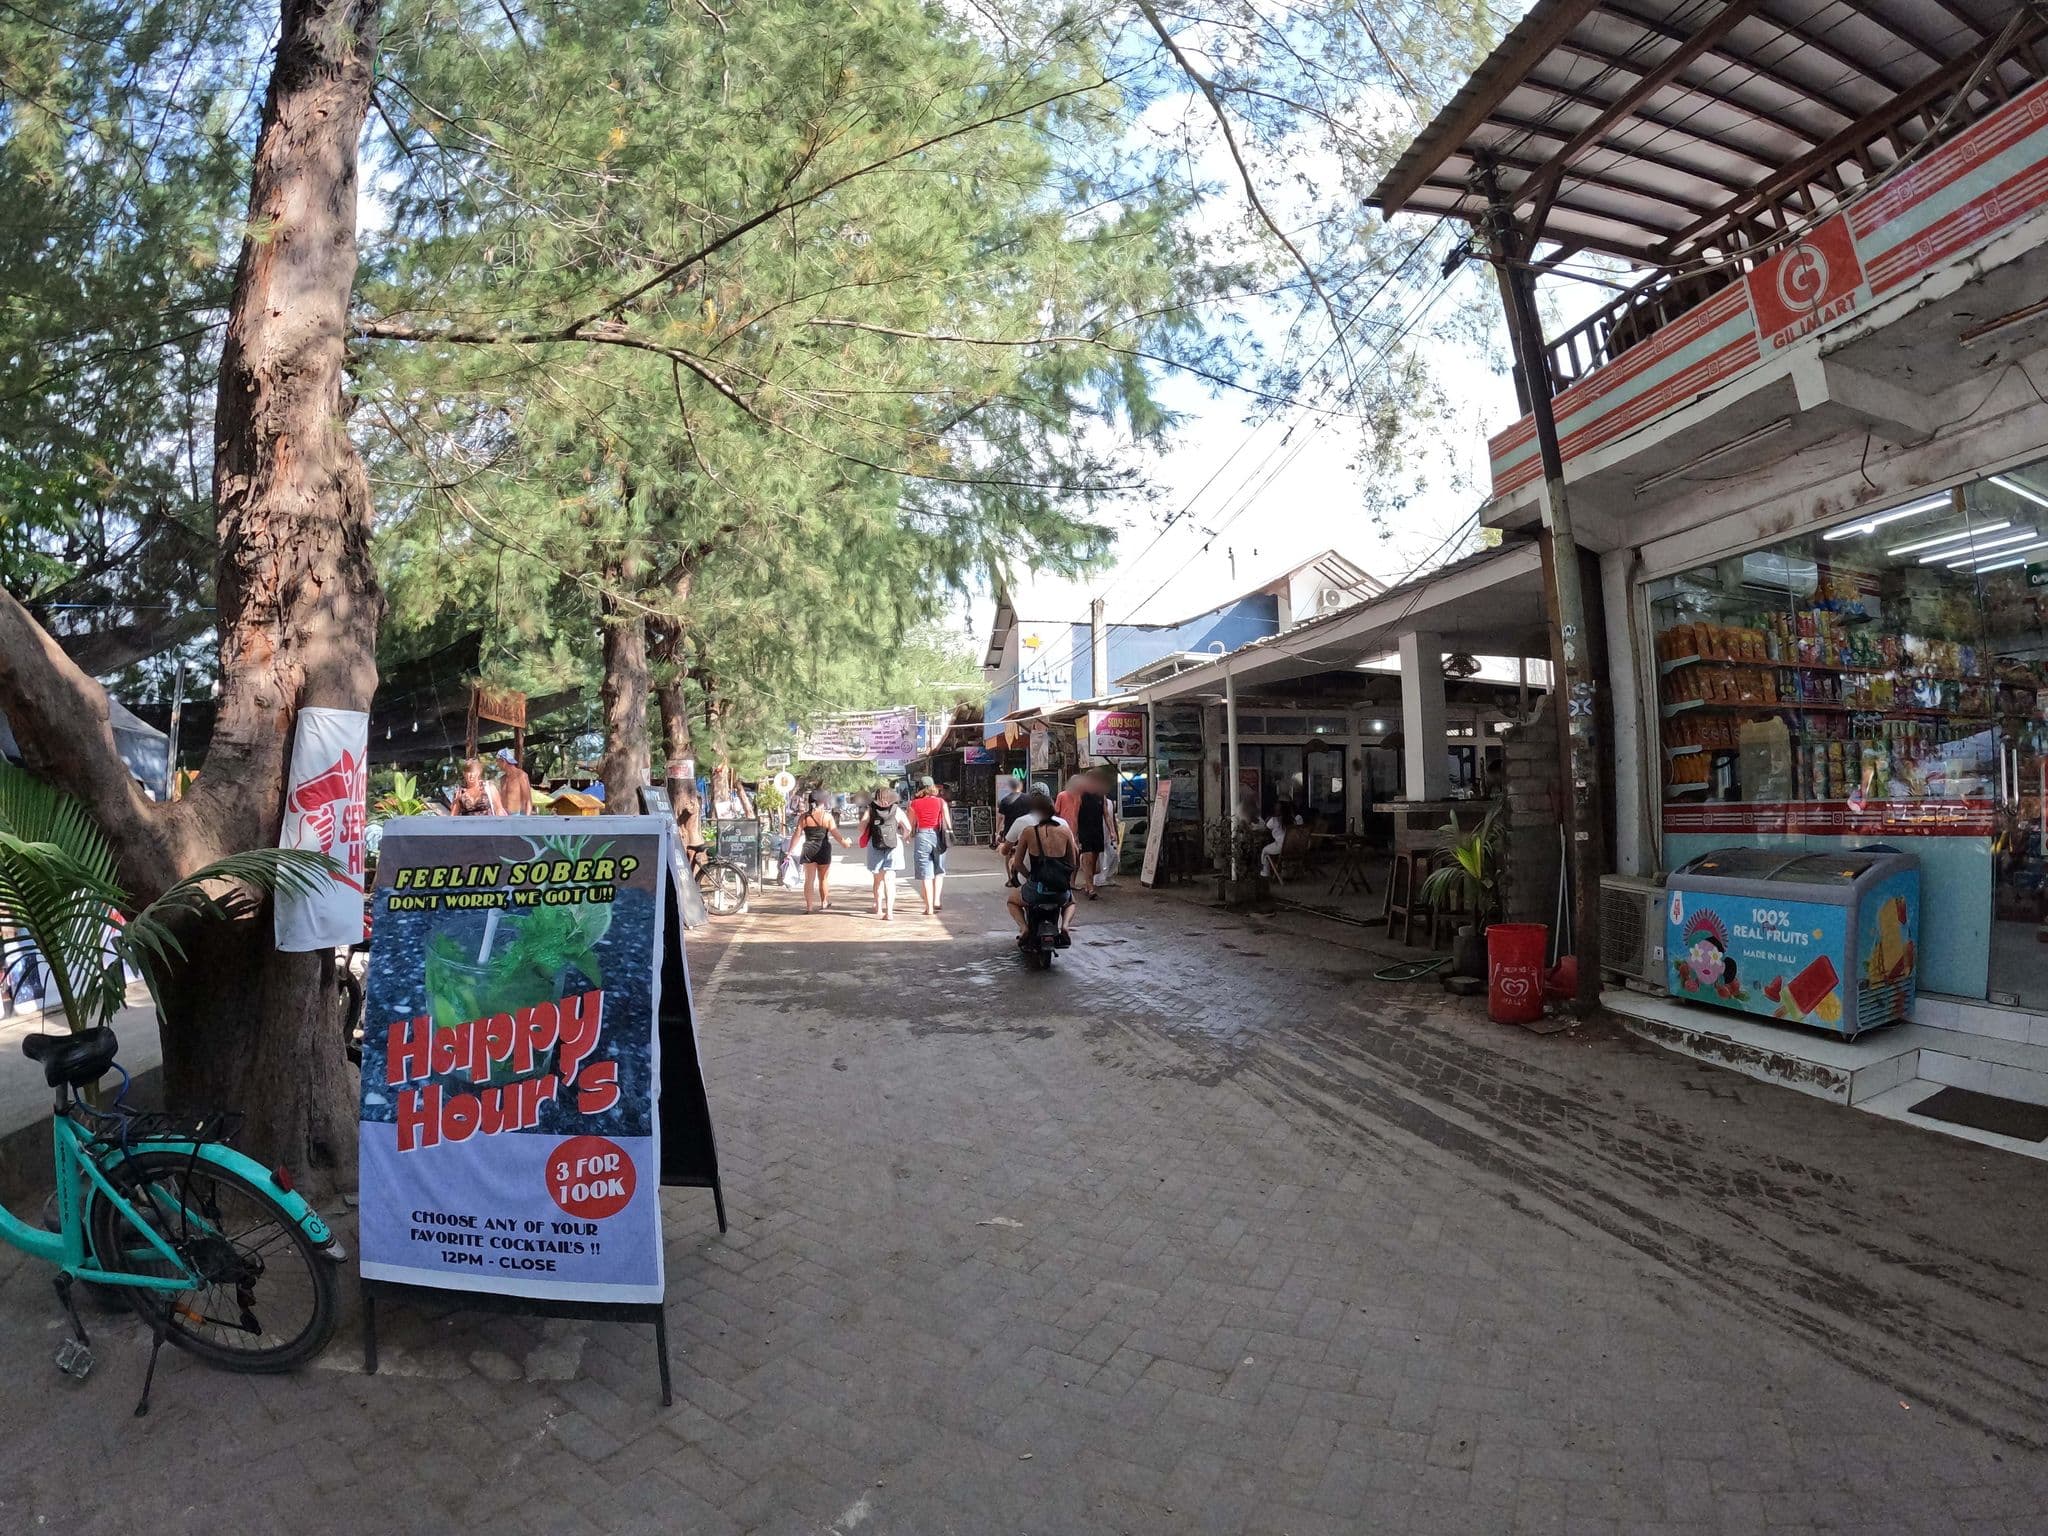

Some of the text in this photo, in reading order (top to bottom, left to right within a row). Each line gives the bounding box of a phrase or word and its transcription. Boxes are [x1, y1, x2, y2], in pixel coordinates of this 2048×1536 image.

[395, 857, 638, 889] FEELIN SOBER?
[389, 888, 614, 910] DON'T WORRY, WE GOT U!!
[1752, 908, 1790, 927] 100%
[1733, 925, 1763, 940] REAL
[1766, 929, 1809, 946] FRUITS
[1743, 949, 1796, 964] MADE IN BALI
[387, 989, 604, 1086] Happy
[556, 1153, 620, 1181] 3 FOR
[559, 1177, 626, 1204] 100K
[411, 1210, 598, 1236] CHOOSE ANY OF YOUR
[410, 1229, 484, 1247] FAVORITE
[490, 1236, 585, 1255] COCKTAIL'S
[441, 1251, 483, 1266] 12PM
[499, 1257, 557, 1272] CLOSE
